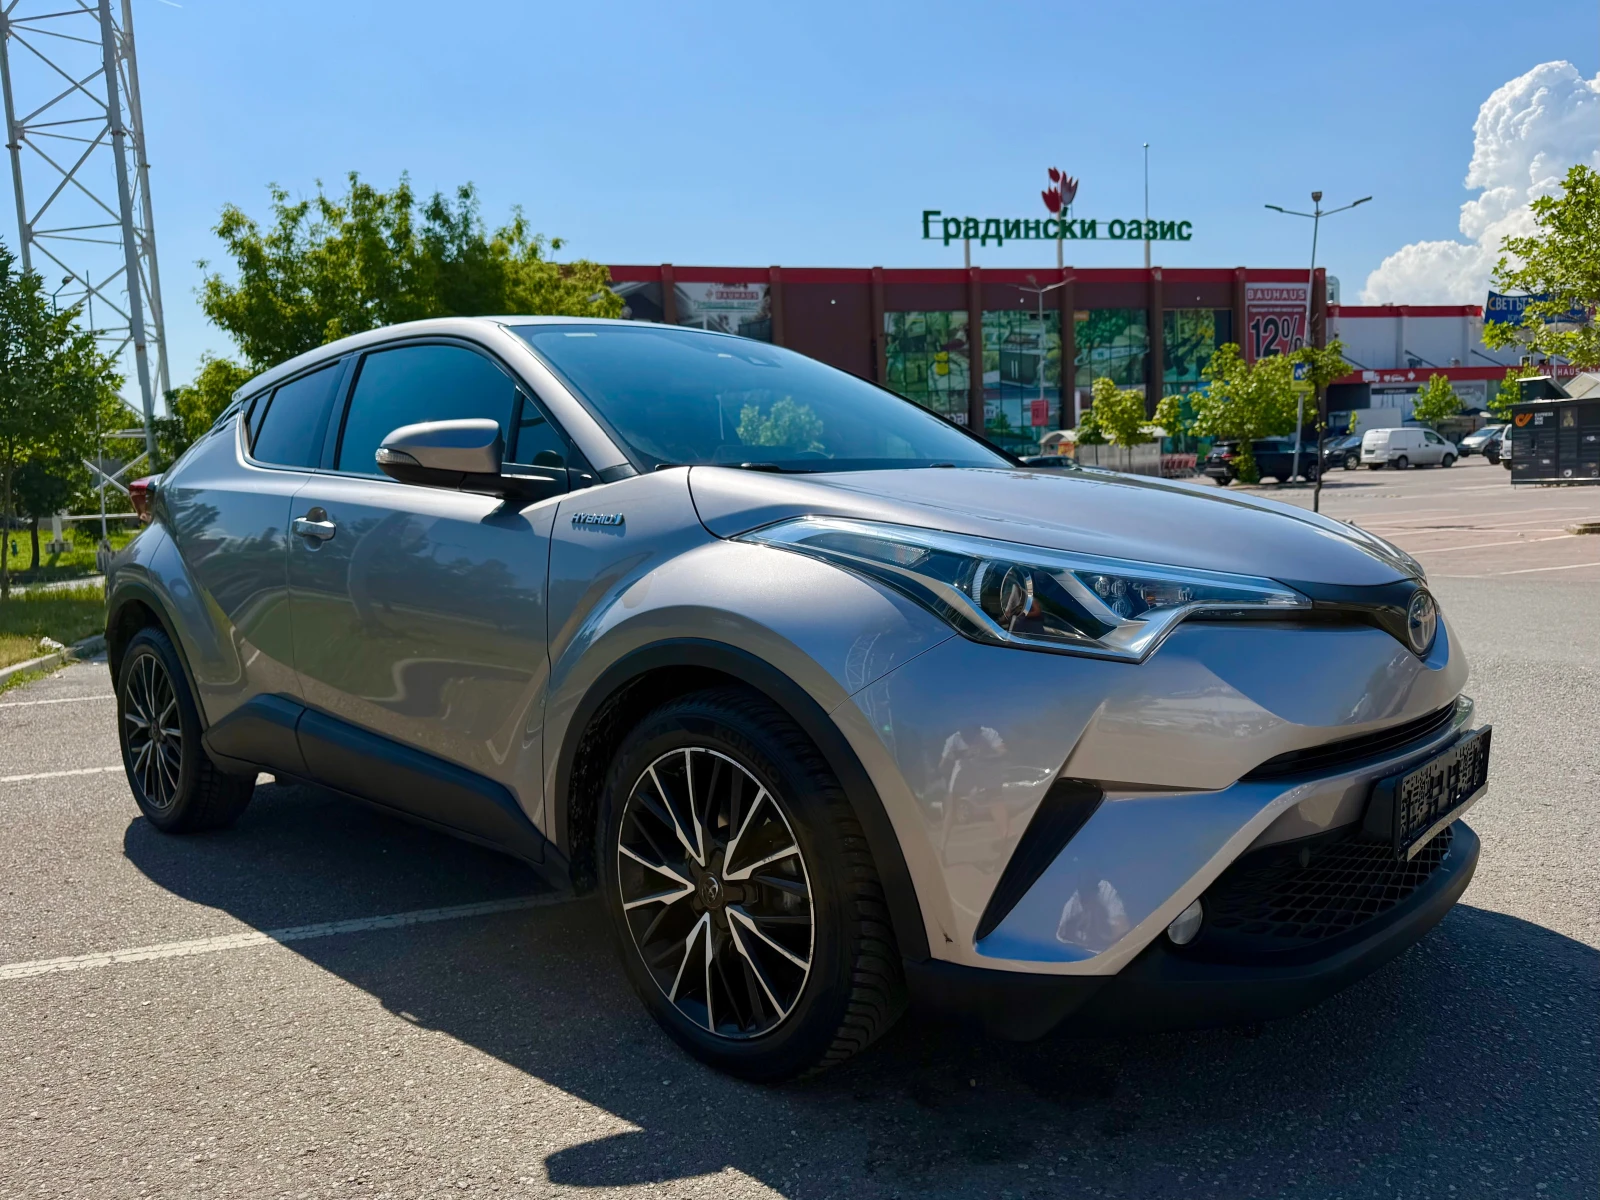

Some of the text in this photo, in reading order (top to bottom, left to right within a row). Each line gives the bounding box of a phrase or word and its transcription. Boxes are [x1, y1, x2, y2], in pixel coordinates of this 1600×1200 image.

[923, 207, 1193, 247] Градински оазис
[715, 291, 758, 299] BAUHAUS
[1247, 289, 1305, 300] BAUHAUS
[1250, 315, 1304, 359] 12%
[571, 512, 614, 525] HYBRID
